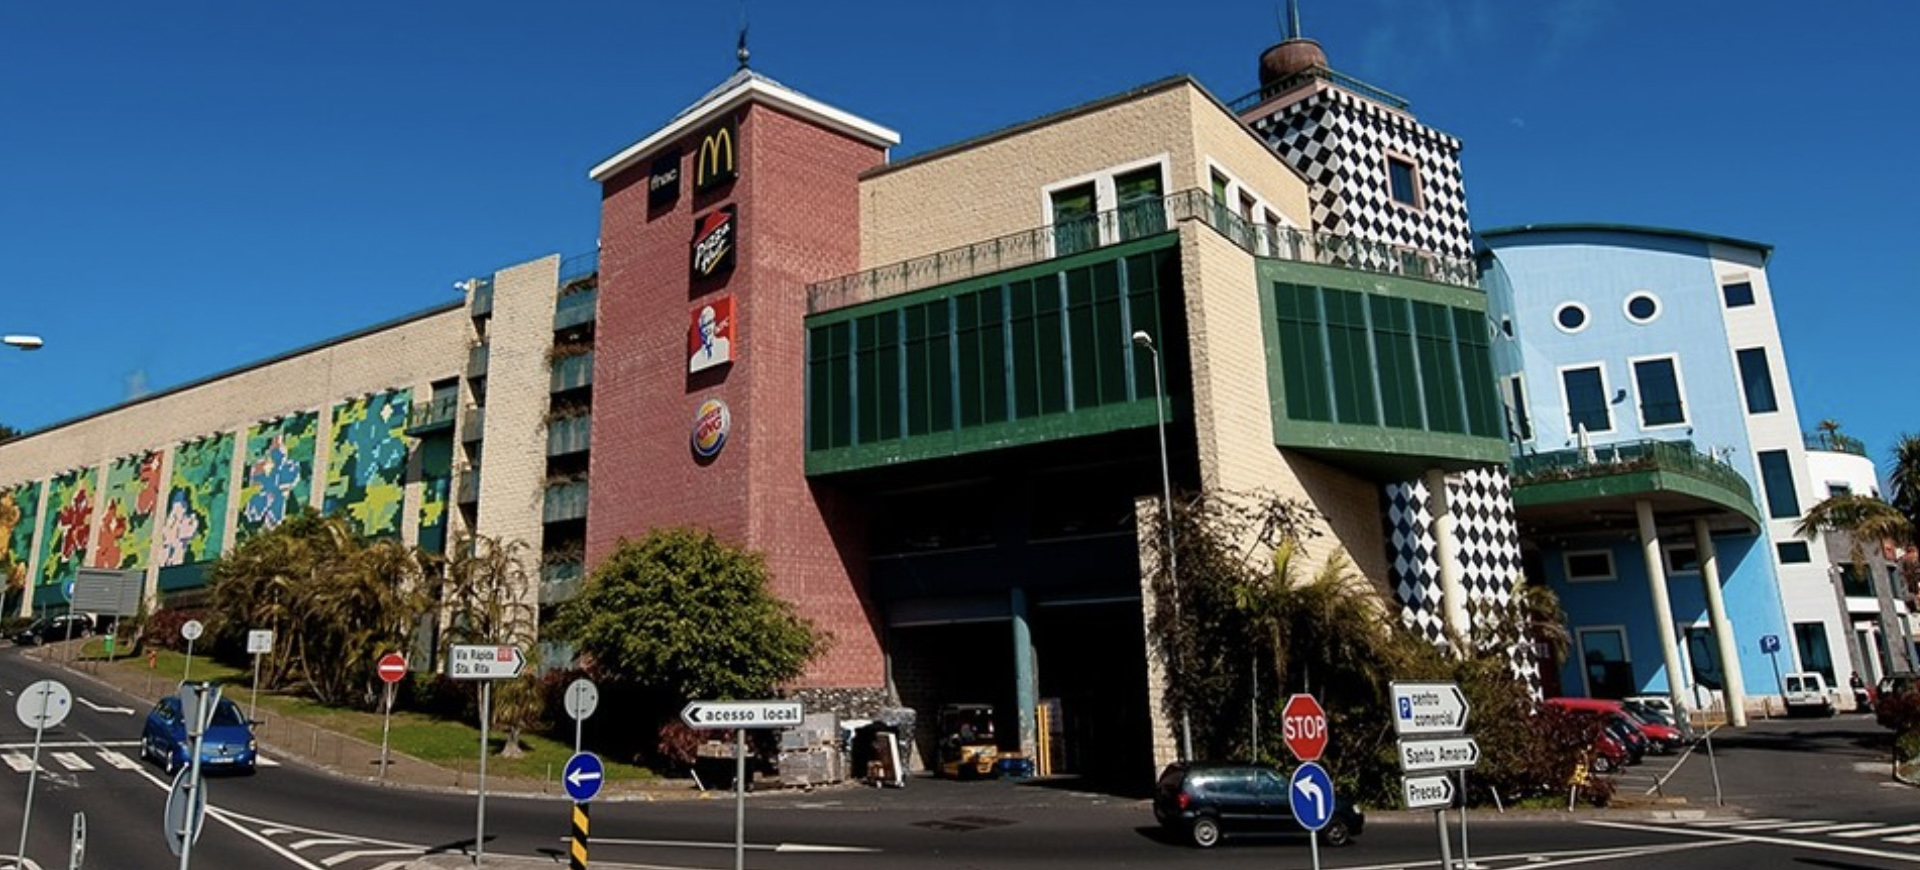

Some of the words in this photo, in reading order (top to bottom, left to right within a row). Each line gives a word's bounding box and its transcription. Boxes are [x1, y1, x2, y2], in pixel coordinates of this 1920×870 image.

[651, 168, 677, 191] fnac
[695, 223, 730, 270] Pizza
[1766, 636, 1776, 650] P
[456, 649, 468, 660] Via
[474, 663, 490, 674] Rita
[1412, 691, 1439, 706] centro
[705, 709, 755, 721] acesso
[763, 707, 797, 720] local
[1415, 710, 1454, 727] comercial
[1285, 715, 1326, 740] STOP
[1406, 747, 1435, 764] Santo
[1440, 746, 1467, 761] Amaro
[1410, 784, 1442, 801] Preces
